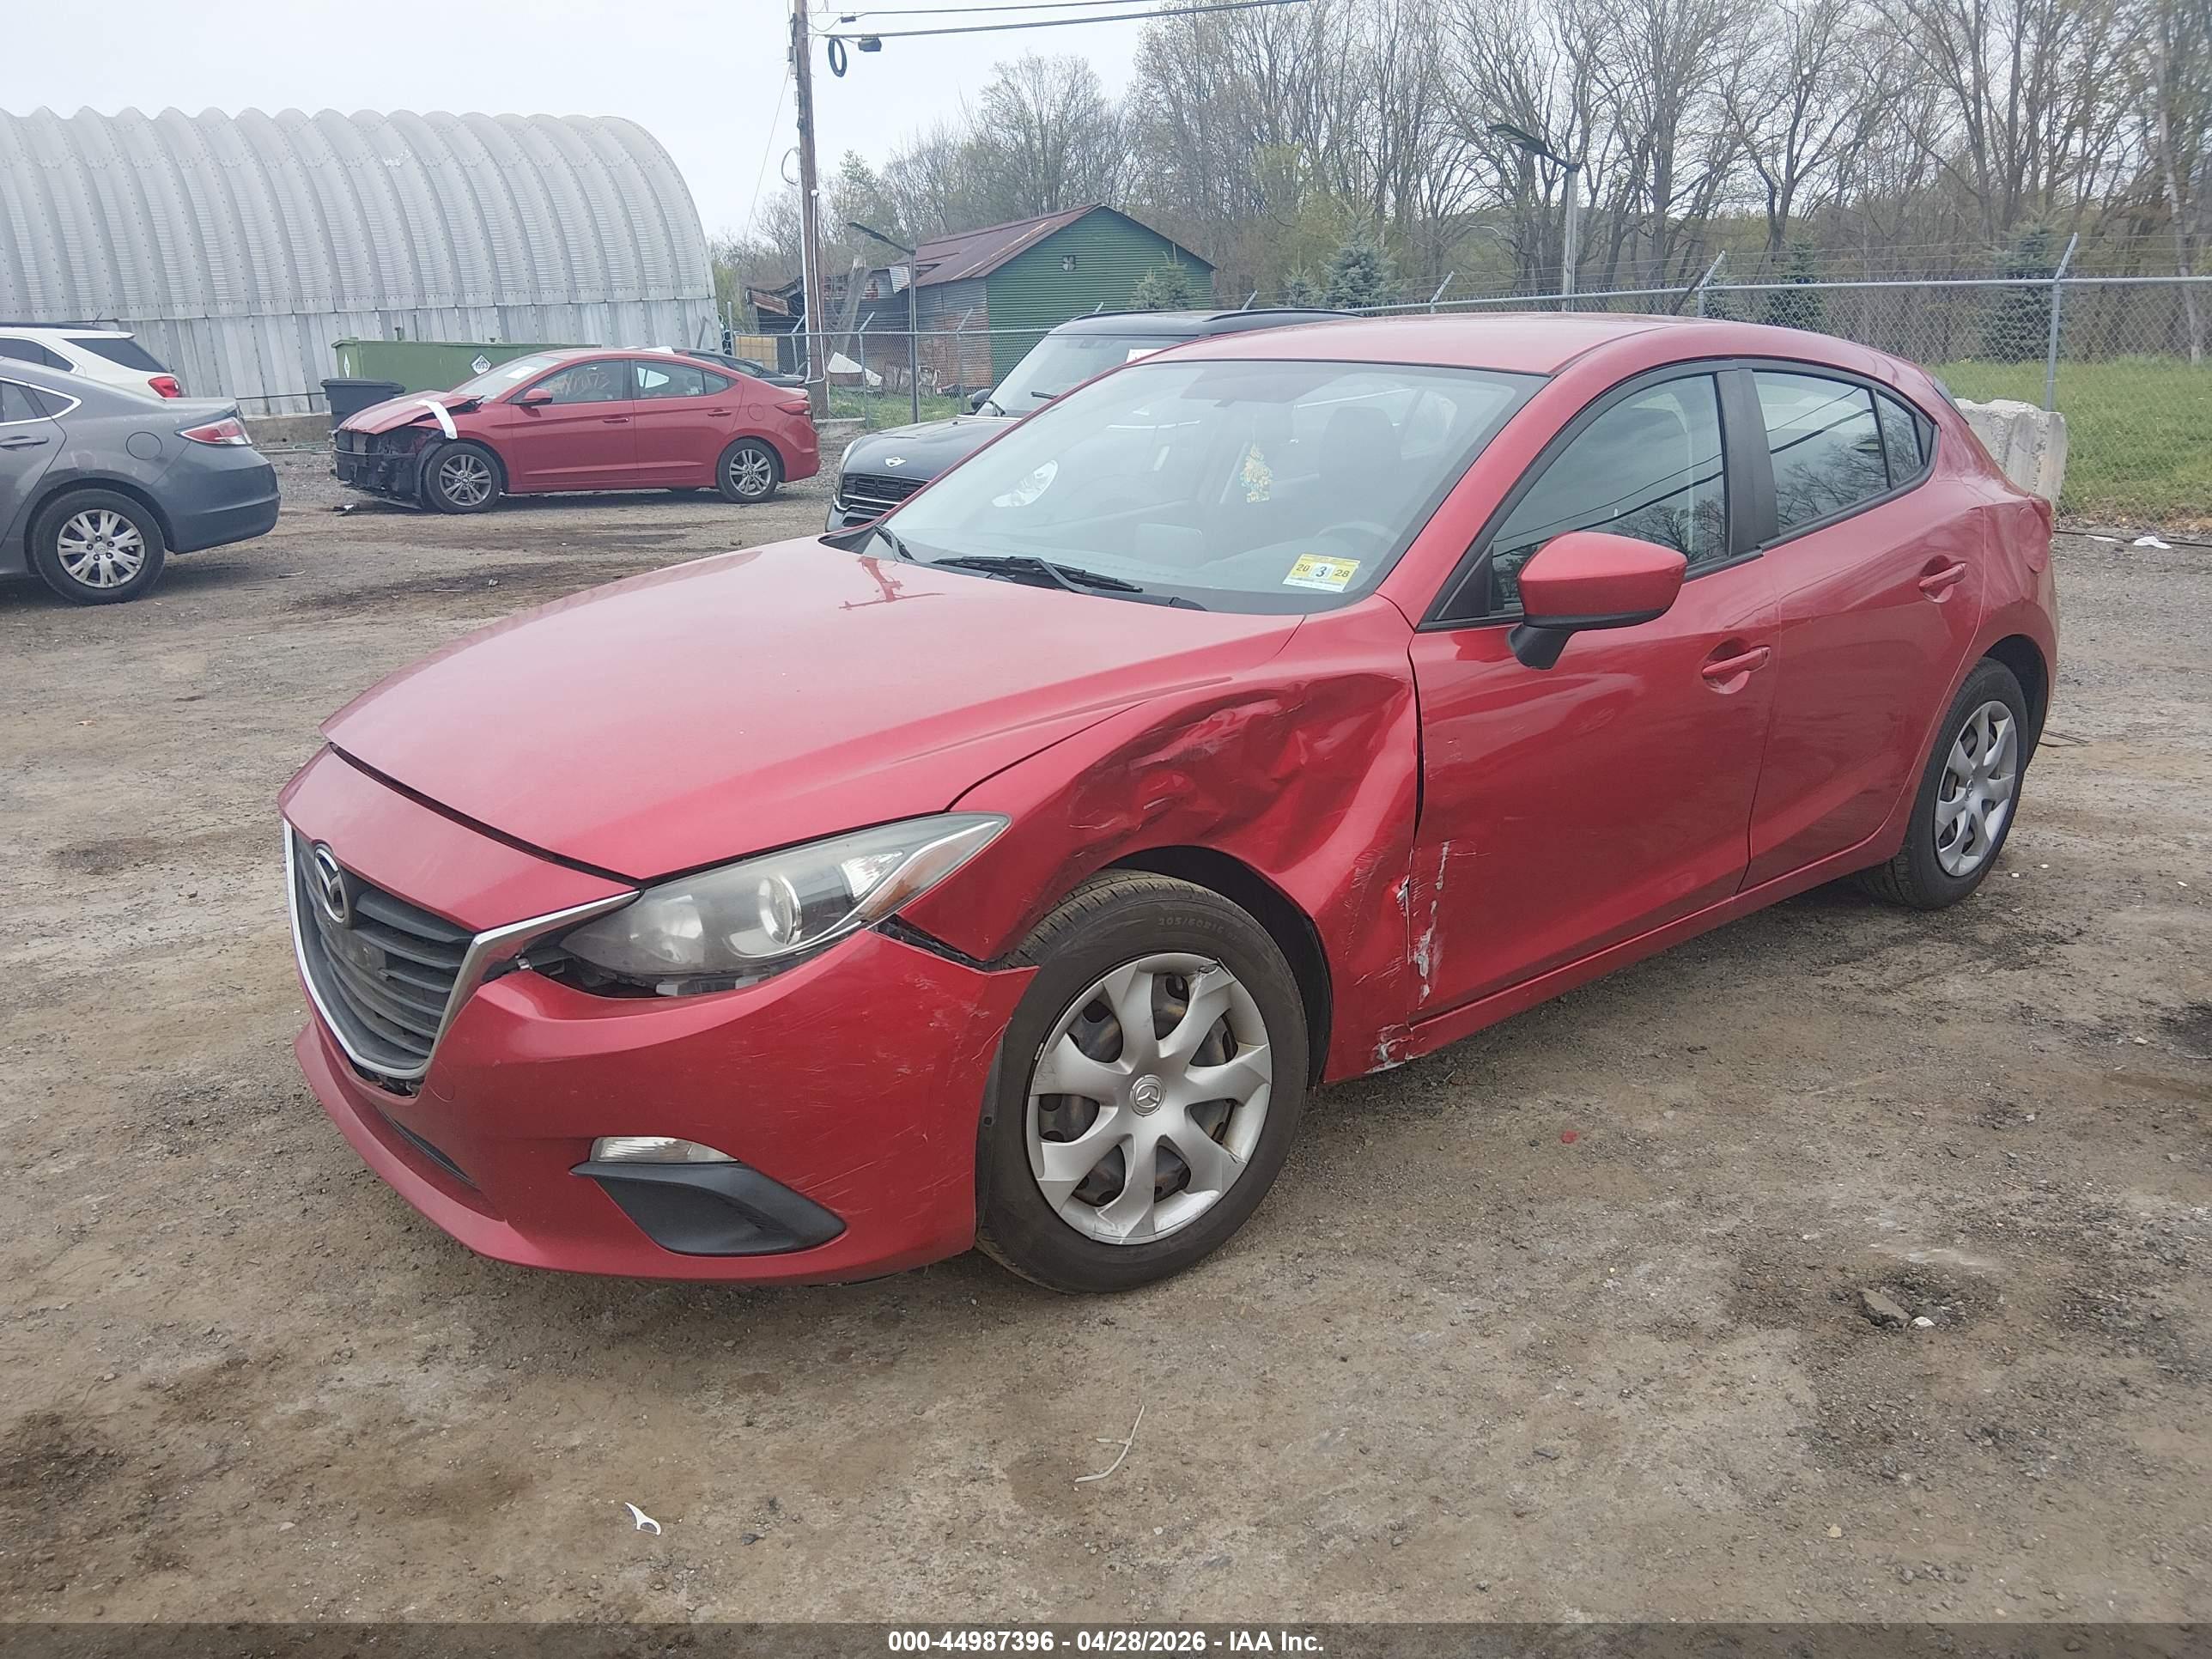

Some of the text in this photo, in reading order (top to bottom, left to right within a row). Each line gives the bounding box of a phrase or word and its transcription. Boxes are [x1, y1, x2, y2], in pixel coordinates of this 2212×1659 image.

[1296, 563, 1350, 578] 20 3 28
